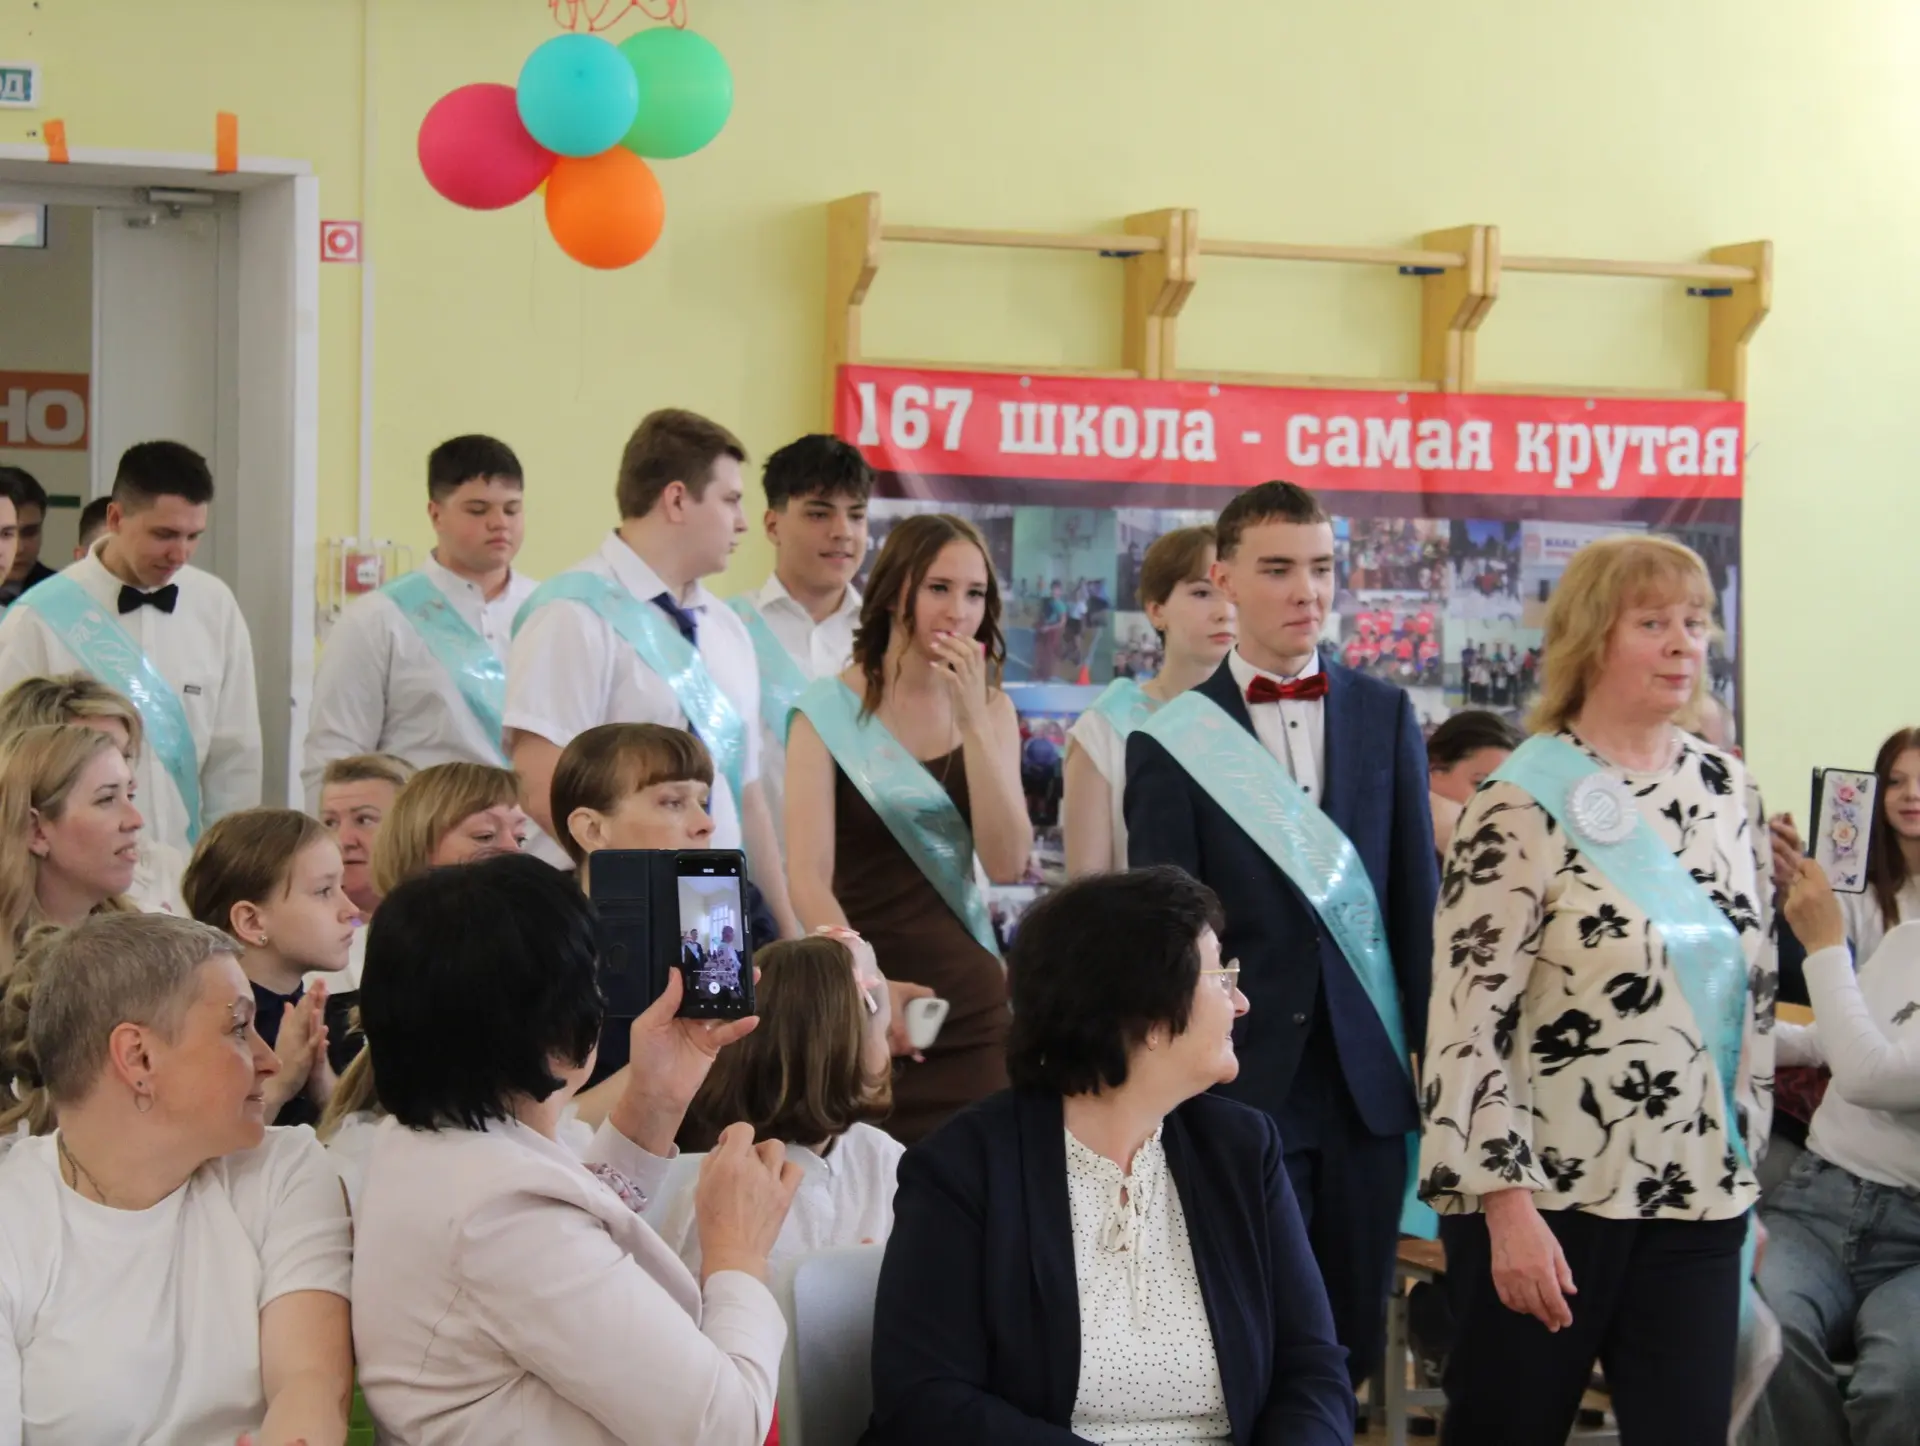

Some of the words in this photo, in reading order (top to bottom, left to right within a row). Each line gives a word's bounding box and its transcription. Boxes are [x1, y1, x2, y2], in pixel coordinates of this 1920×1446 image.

[0, 74, 24, 98] Д
[858, 382, 973, 451] 167
[999, 401, 1217, 462] школа
[1241, 431, 1262, 444] -
[1286, 414, 1493, 471] самая
[1515, 422, 1739, 491] крутая
